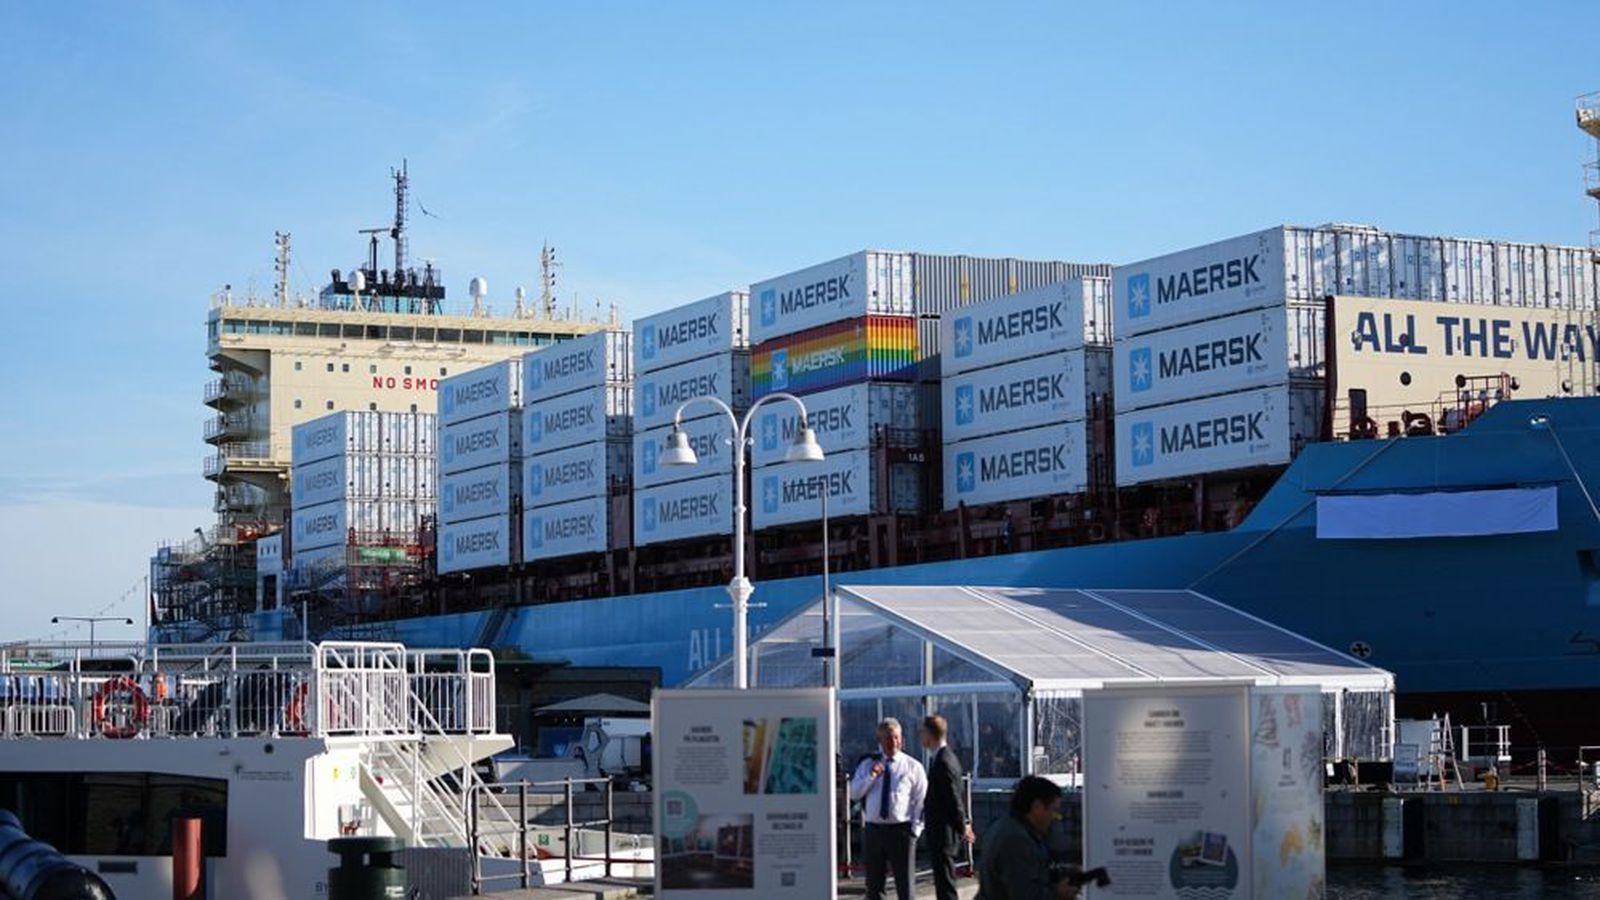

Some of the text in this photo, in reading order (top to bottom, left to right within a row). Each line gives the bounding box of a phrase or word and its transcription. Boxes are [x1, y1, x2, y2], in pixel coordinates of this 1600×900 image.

[1156, 254, 1260, 304] MAERSK
[780, 274, 850, 316] MAERSK
[658, 312, 717, 350] MAERSK
[978, 302, 1063, 345] MAERSK
[1355, 312, 1427, 354] ALL
[1437, 316, 1512, 359] THE
[543, 352, 594, 380] MAERSK
[791, 348, 845, 374] MAERSK
[1158, 332, 1262, 379] MAERSK
[373, 376, 439, 391] NO SMO
[455, 379, 499, 406] MAERSK
[658, 372, 718, 408] MAERSK
[979, 373, 1065, 414] MAERSK
[544, 404, 594, 431] MAERSK
[1160, 411, 1264, 455] MAERSK
[455, 430, 499, 456] MAERSK
[544, 458, 595, 485] MAERSK
[981, 444, 1066, 483] MAERSK
[455, 480, 499, 503] MAERSK
[783, 470, 853, 503] MAERSK
[659, 492, 718, 523] MAERSK
[305, 513, 338, 535] MAERSK
[544, 510, 595, 537] MAERSK
[455, 529, 499, 553] MAERSK
